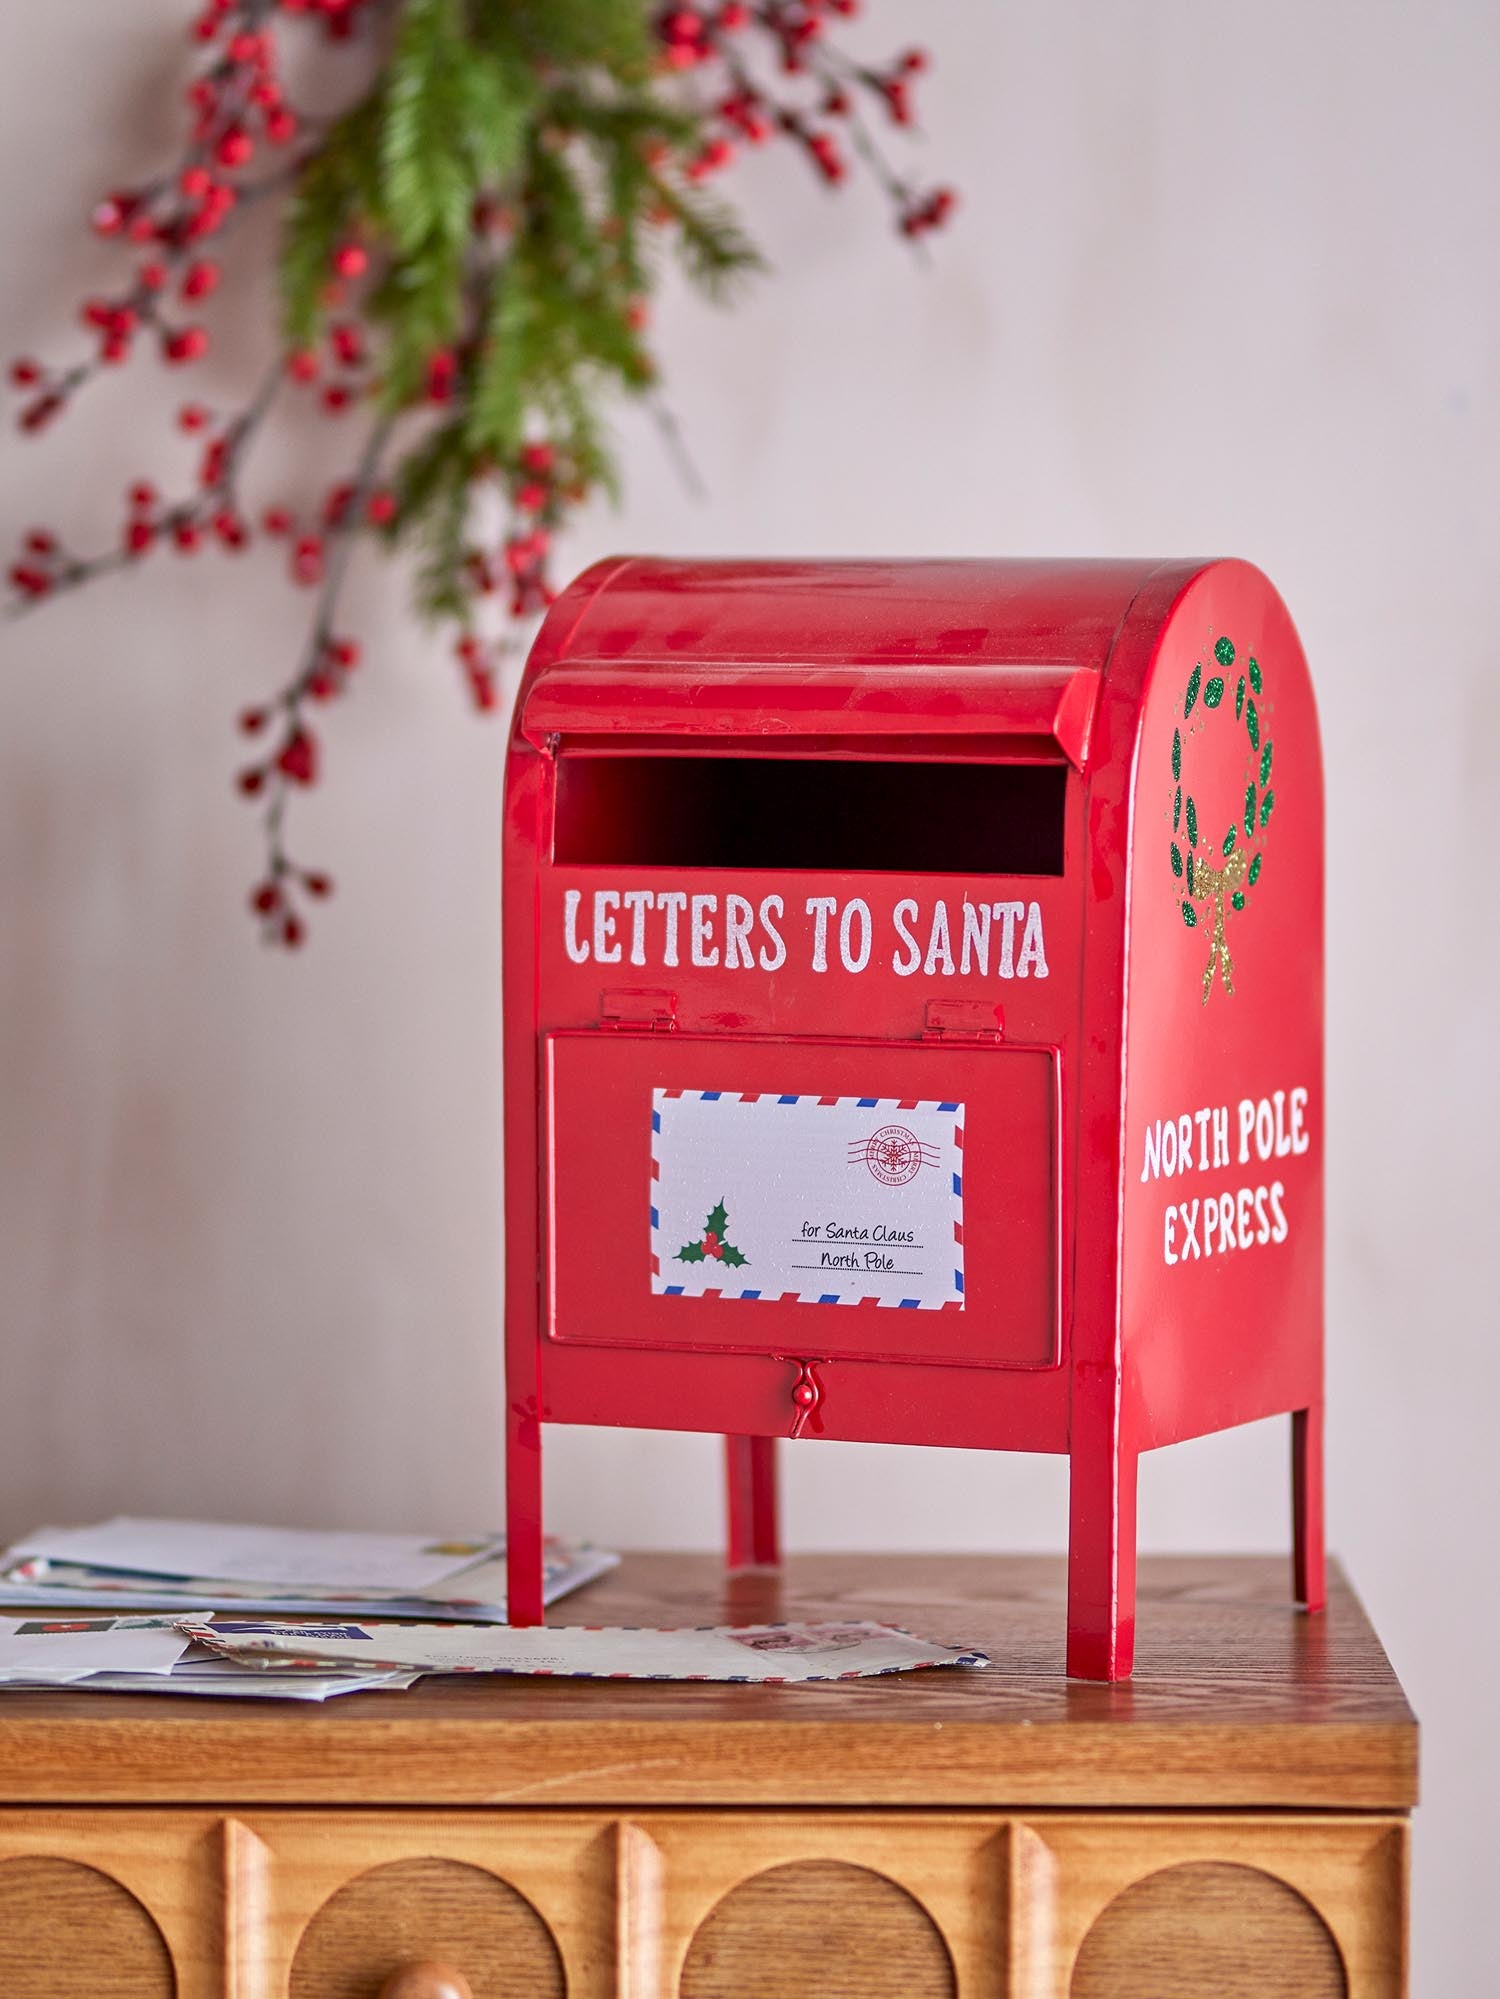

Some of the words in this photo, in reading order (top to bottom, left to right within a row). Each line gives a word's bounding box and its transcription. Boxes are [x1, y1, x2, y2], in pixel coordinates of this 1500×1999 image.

[564, 889, 787, 973] LETTERS
[805, 896, 873, 974] TO
[891, 897, 1049, 979] SANTA
[1140, 1105, 1230, 1184] NORTH
[1238, 1086, 1310, 1165] POLE
[801, 1220, 822, 1238] for
[825, 1222, 870, 1240] Santa
[872, 1225, 915, 1242] Claus
[820, 1251, 860, 1268] North
[864, 1251, 895, 1270] Pole
[1163, 1181, 1289, 1266] EXPRESS
